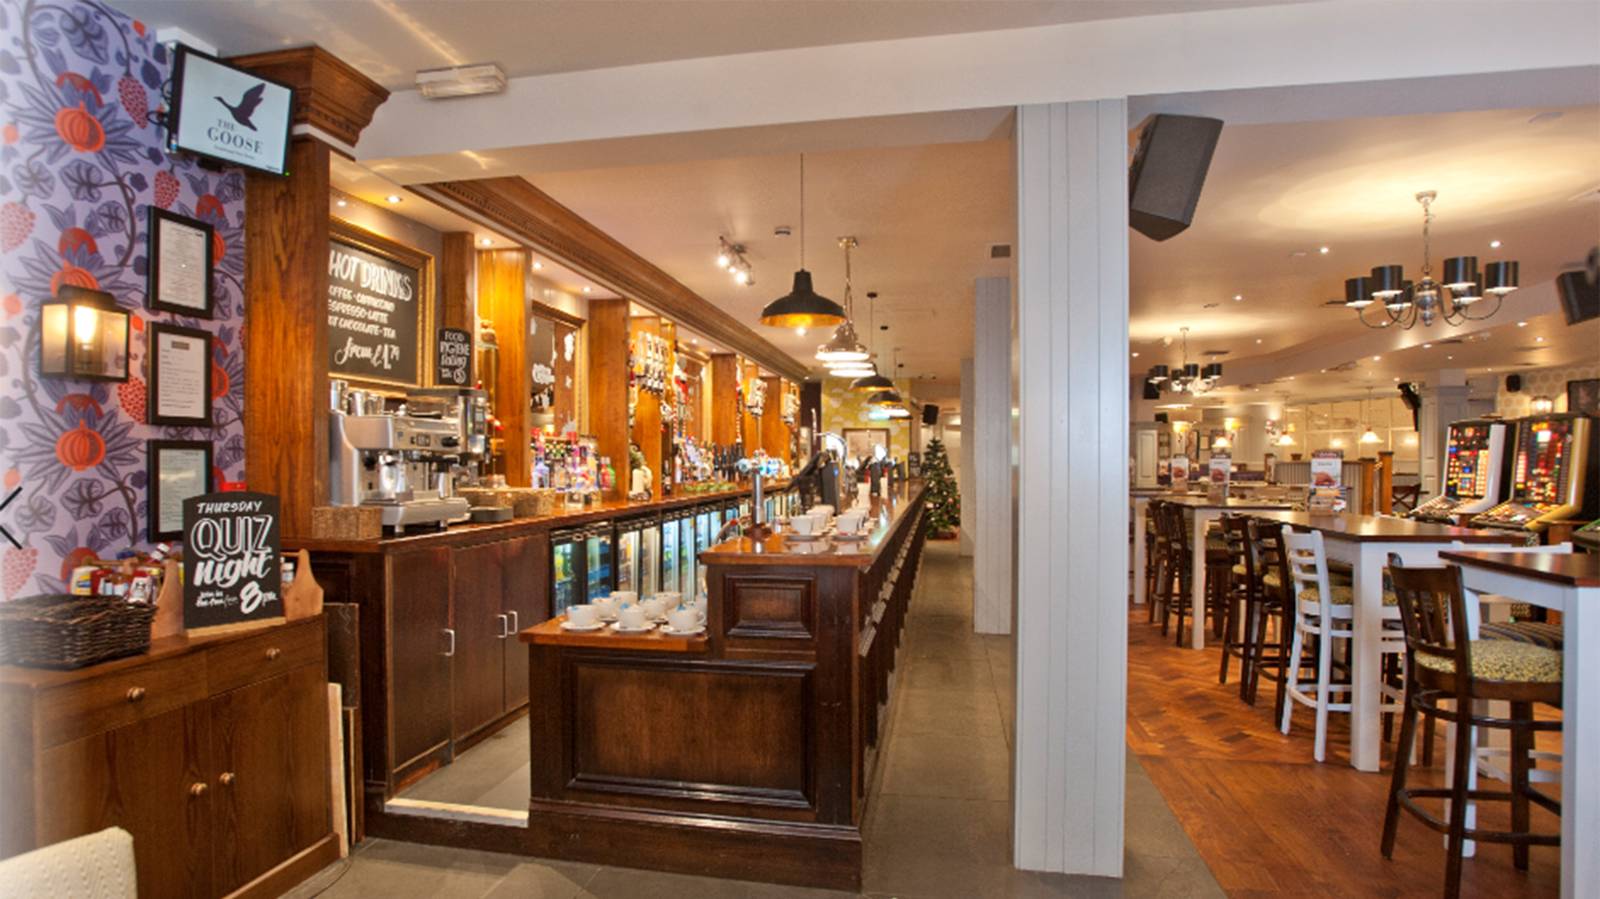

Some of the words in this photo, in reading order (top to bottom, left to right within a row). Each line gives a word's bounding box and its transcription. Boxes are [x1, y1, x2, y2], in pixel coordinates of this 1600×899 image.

[207, 127, 263, 154] GOOSE
[329, 249, 361, 283] HOT
[361, 263, 412, 301] DRINKS
[197, 501, 263, 514] THURSDAY
[191, 515, 273, 561] QUIZ
[194, 551, 274, 588] night
